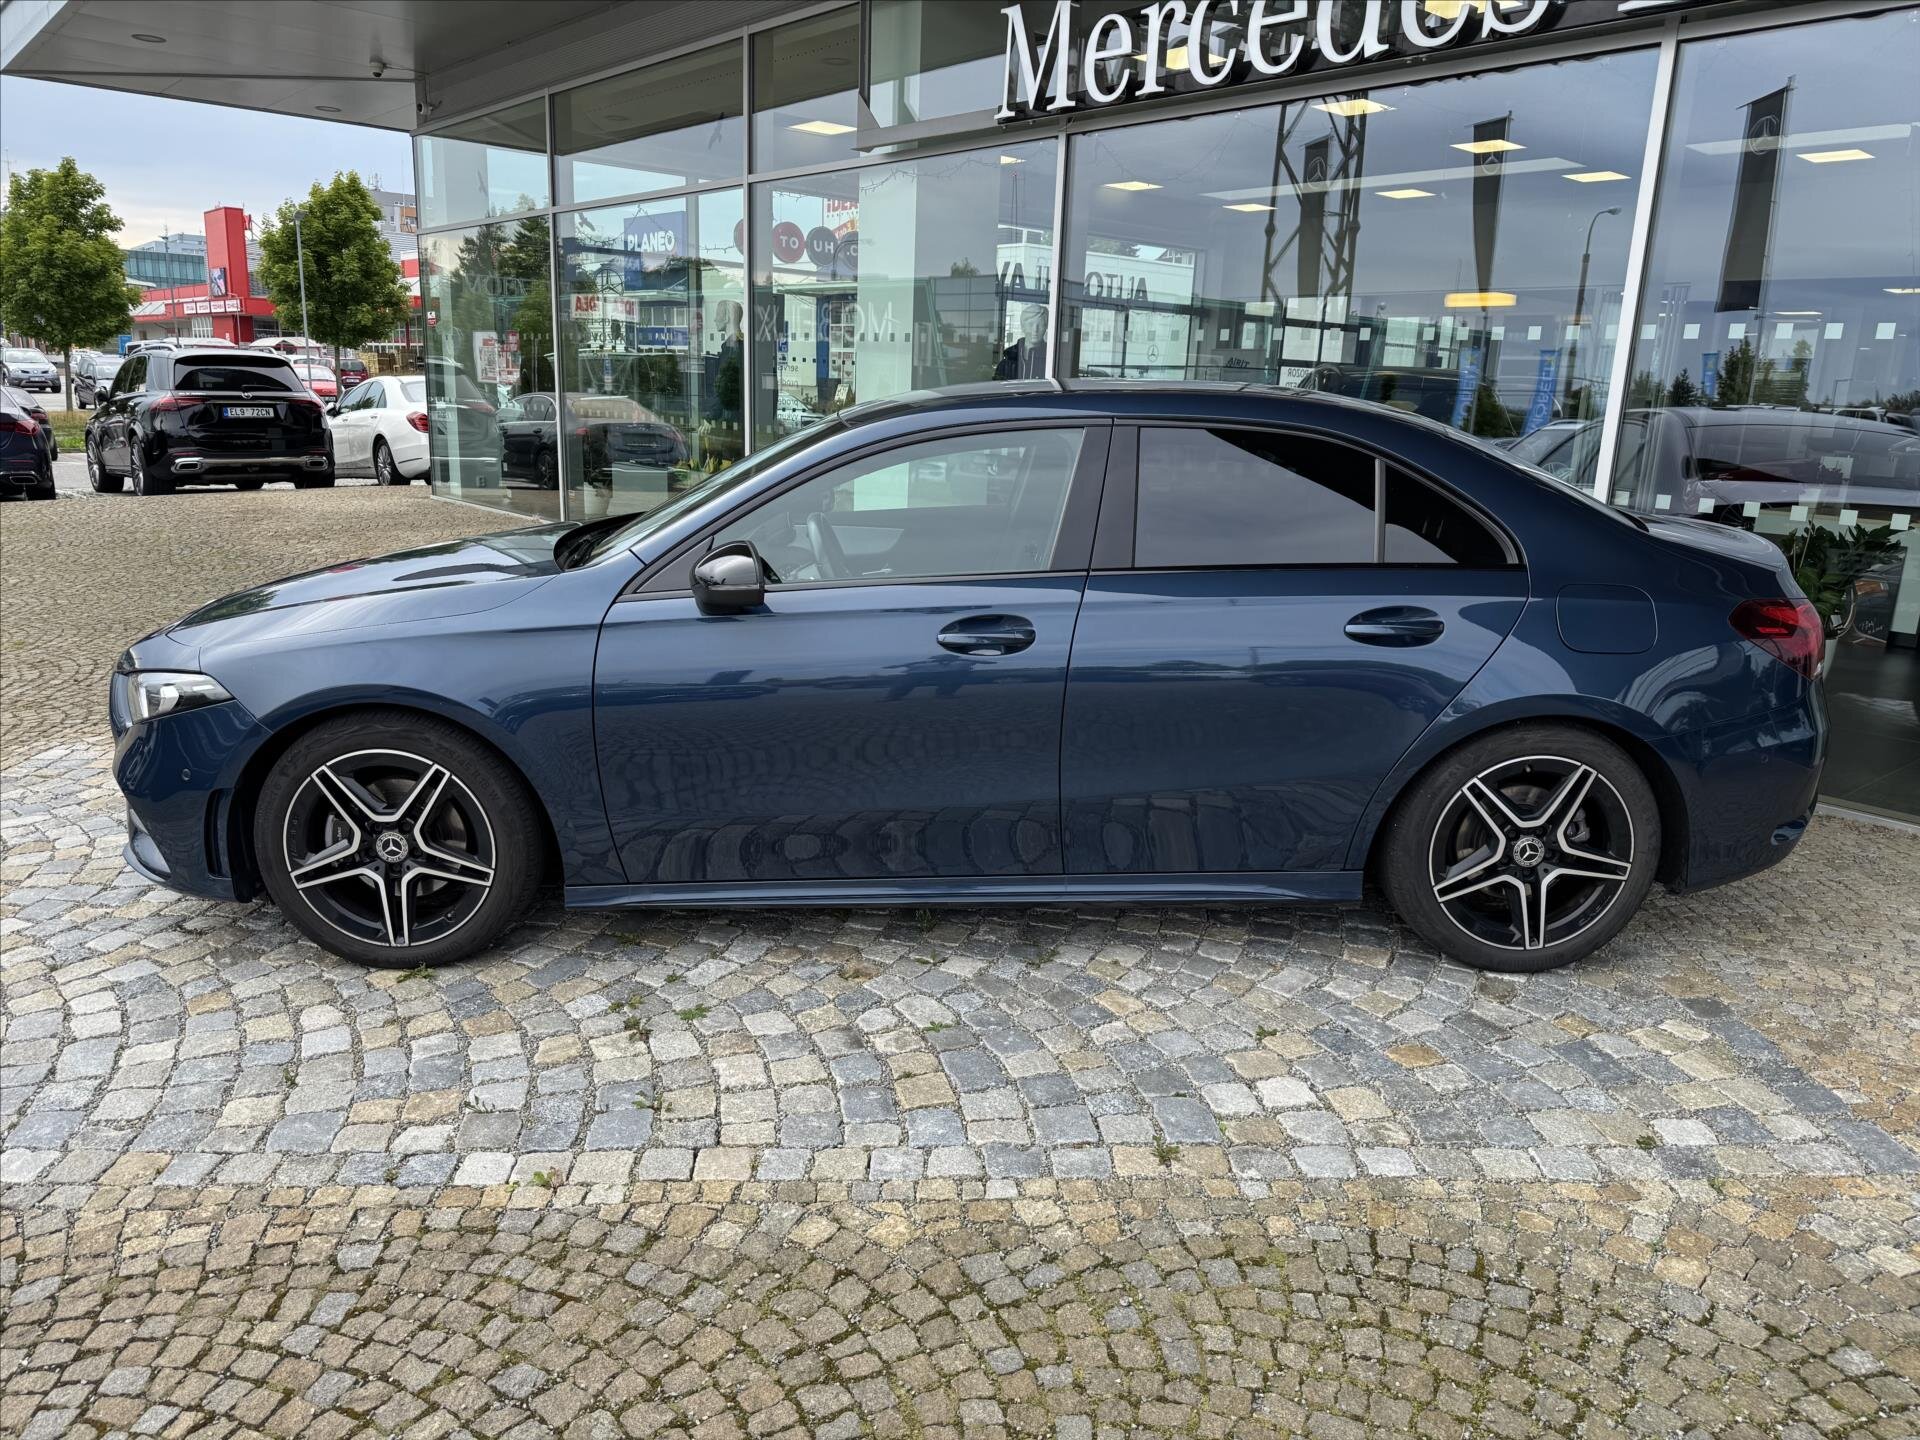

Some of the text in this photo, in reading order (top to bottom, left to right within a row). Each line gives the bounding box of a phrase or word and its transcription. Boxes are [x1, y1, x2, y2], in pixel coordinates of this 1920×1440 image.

[627, 230, 676, 252] PLANEO
[780, 235, 799, 248] TO
[814, 238, 834, 254] UH
[230, 408, 270, 416] EL9 72CN
